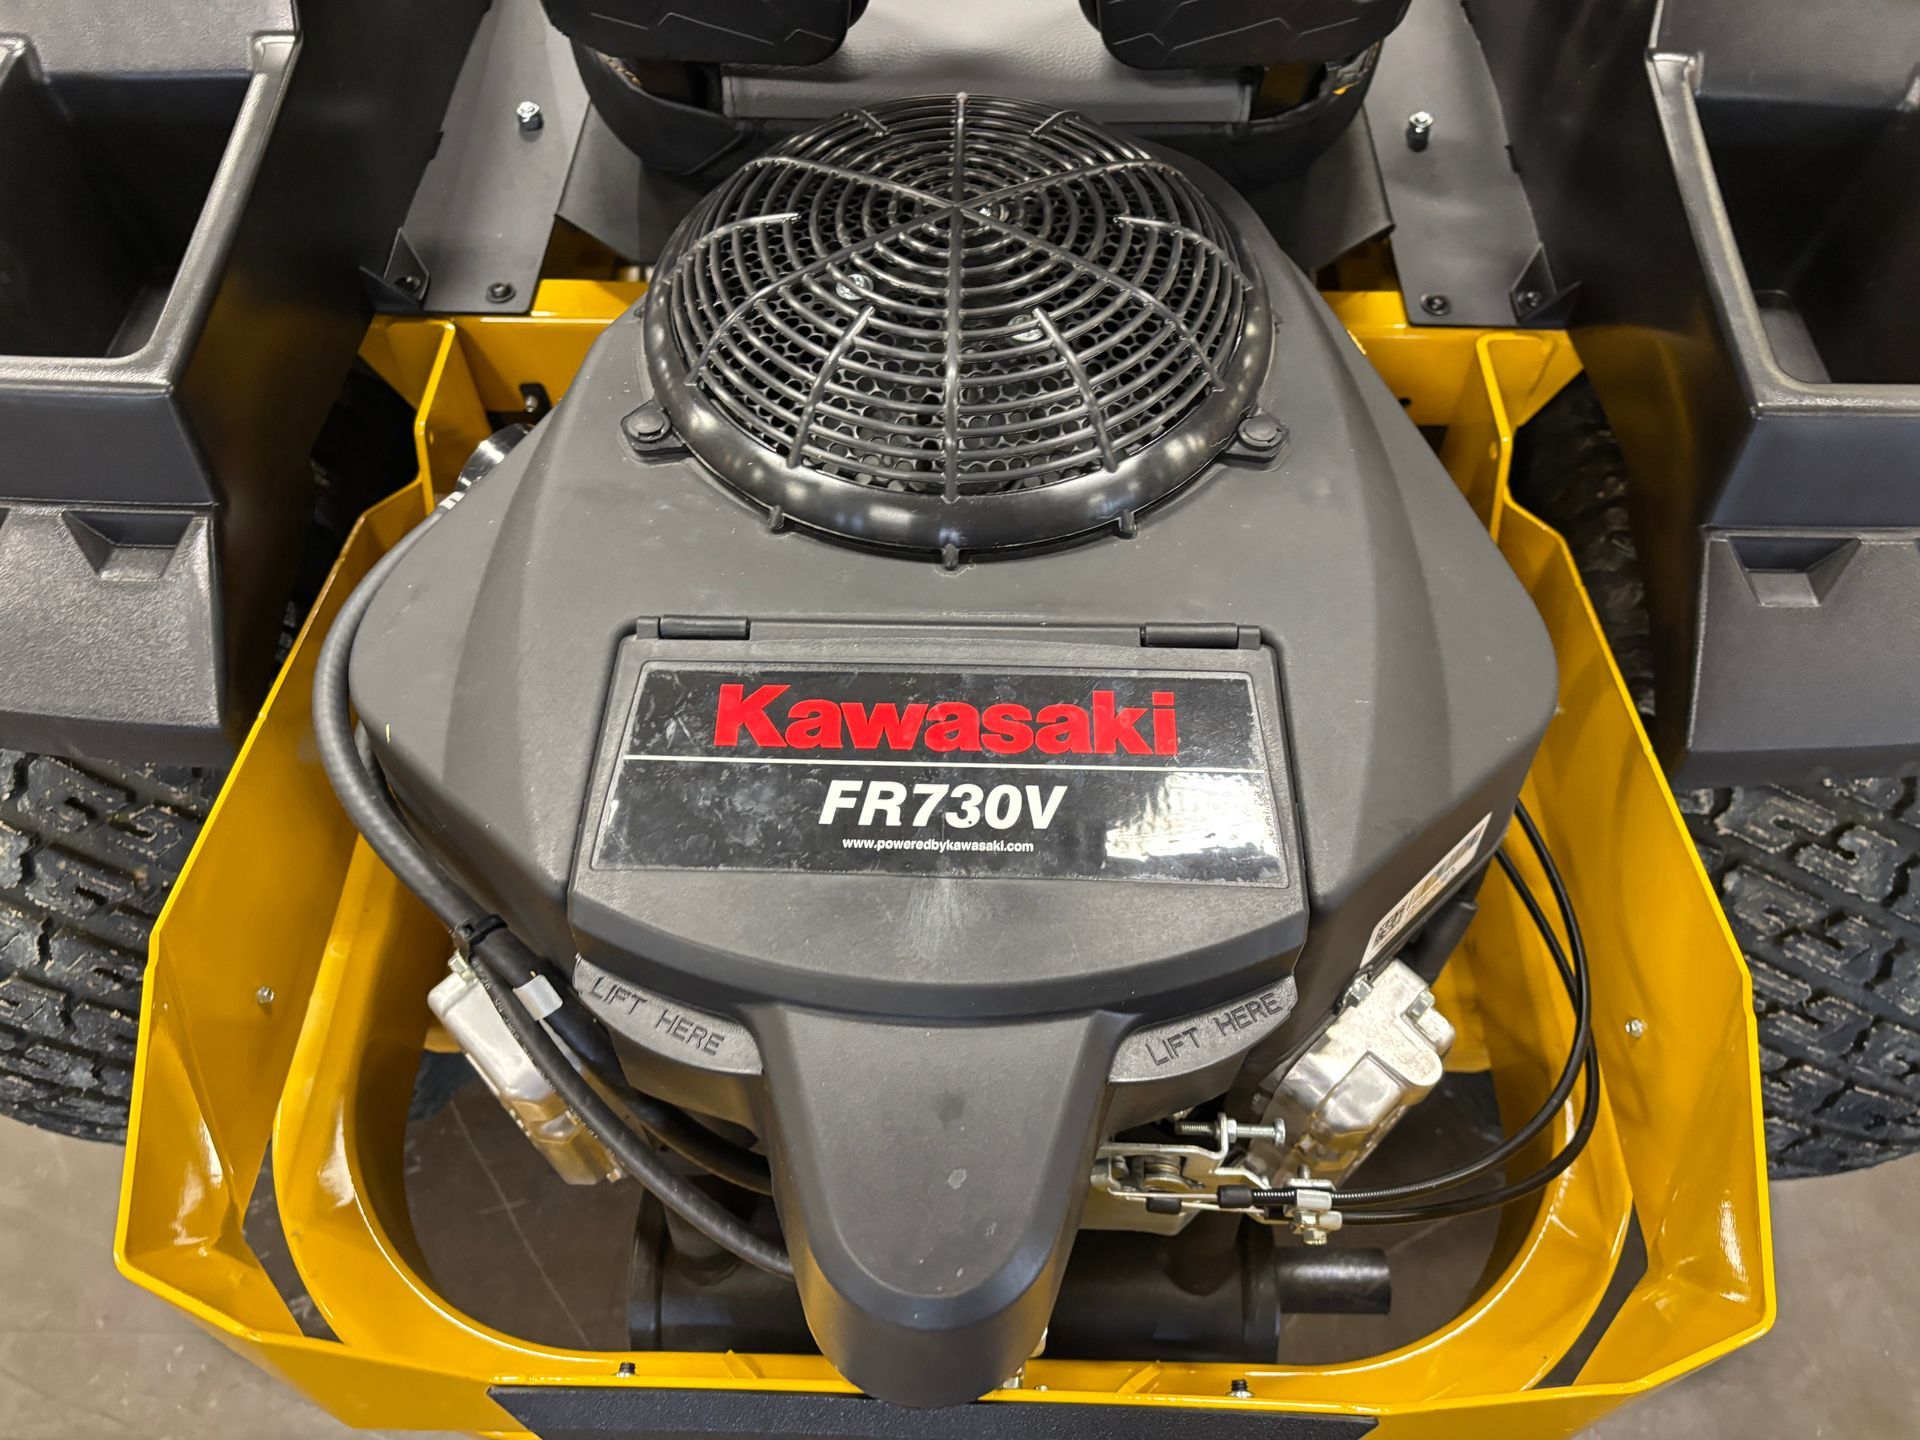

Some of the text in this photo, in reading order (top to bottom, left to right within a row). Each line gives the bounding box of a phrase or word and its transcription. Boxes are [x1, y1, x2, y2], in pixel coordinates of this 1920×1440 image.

[714, 683, 1178, 755] Kawasaki
[818, 780, 1068, 829] FR730V
[842, 837, 1034, 853] www.poweredbykawasaki.com
[591, 976, 725, 1056] LIFT HERE
[1145, 992, 1283, 1066] LIFT HERE
